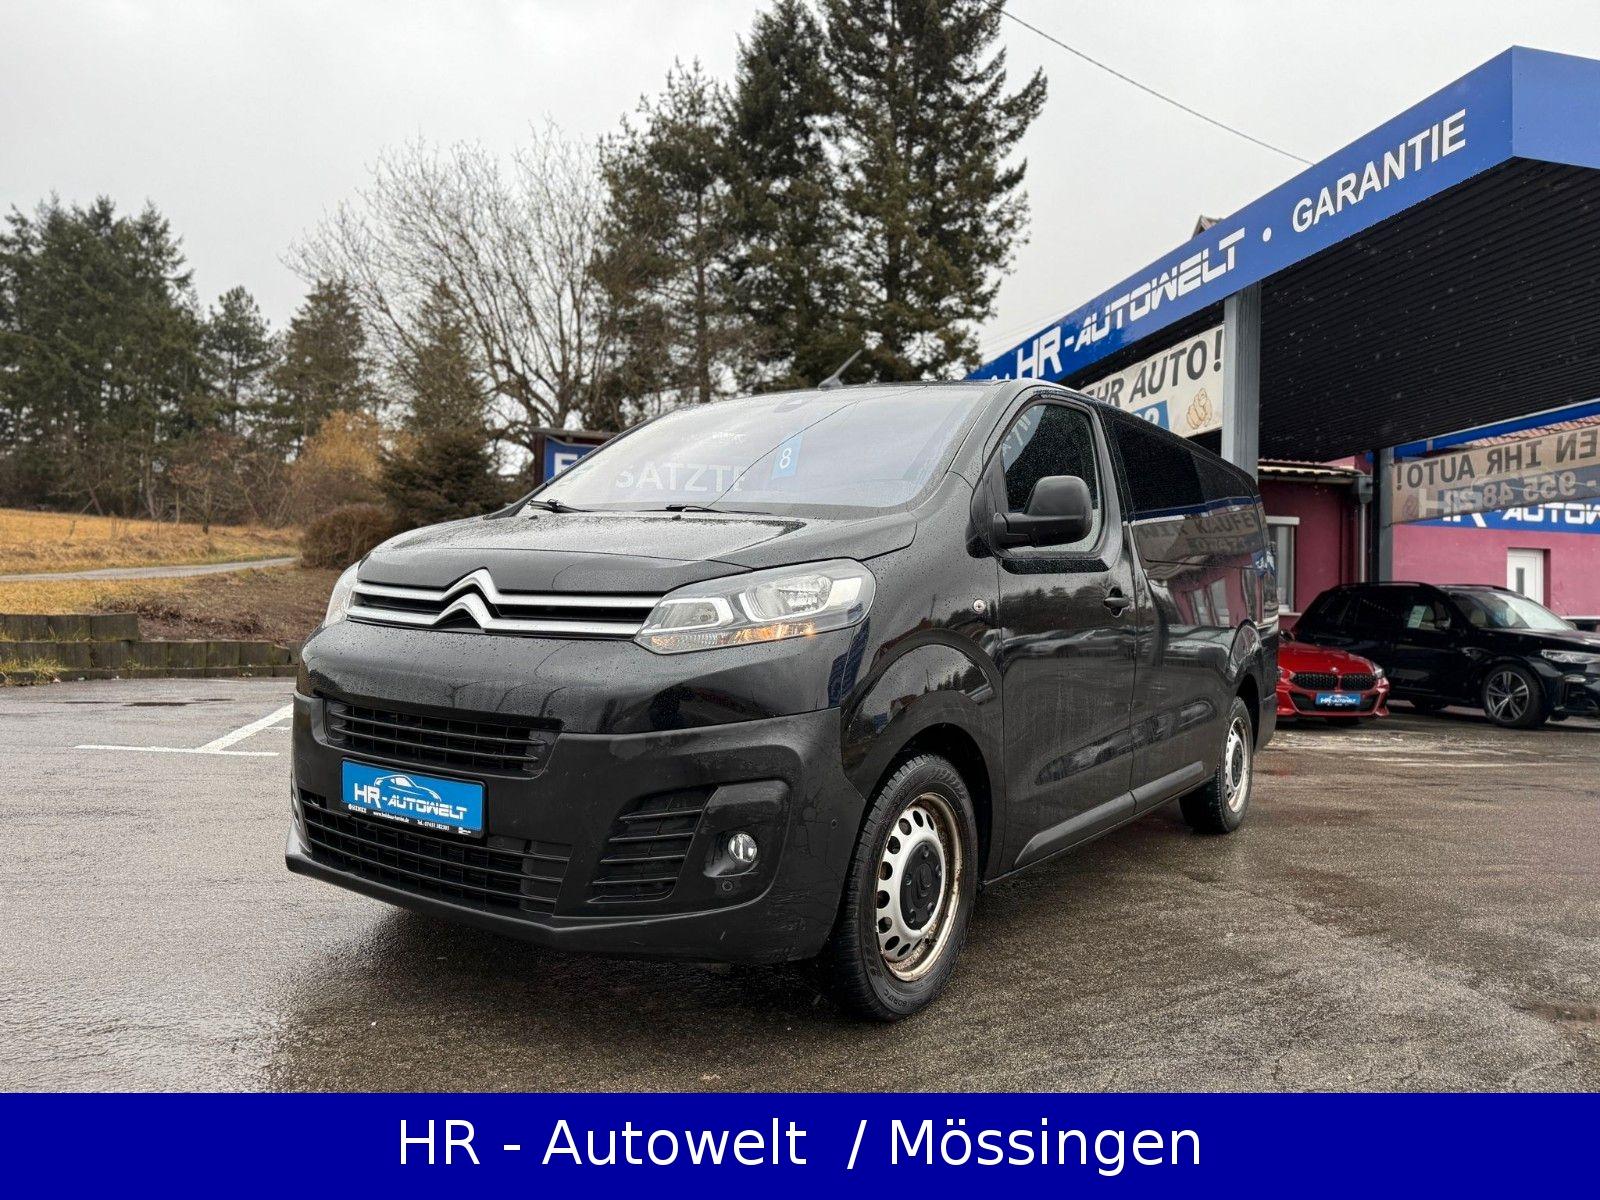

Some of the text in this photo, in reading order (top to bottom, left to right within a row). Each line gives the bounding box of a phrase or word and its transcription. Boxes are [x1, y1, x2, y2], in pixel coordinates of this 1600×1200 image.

[1292, 109, 1466, 233] GARANTIE
[1129, 330, 1223, 404] AUTO!
[779, 448, 792, 470] 8
